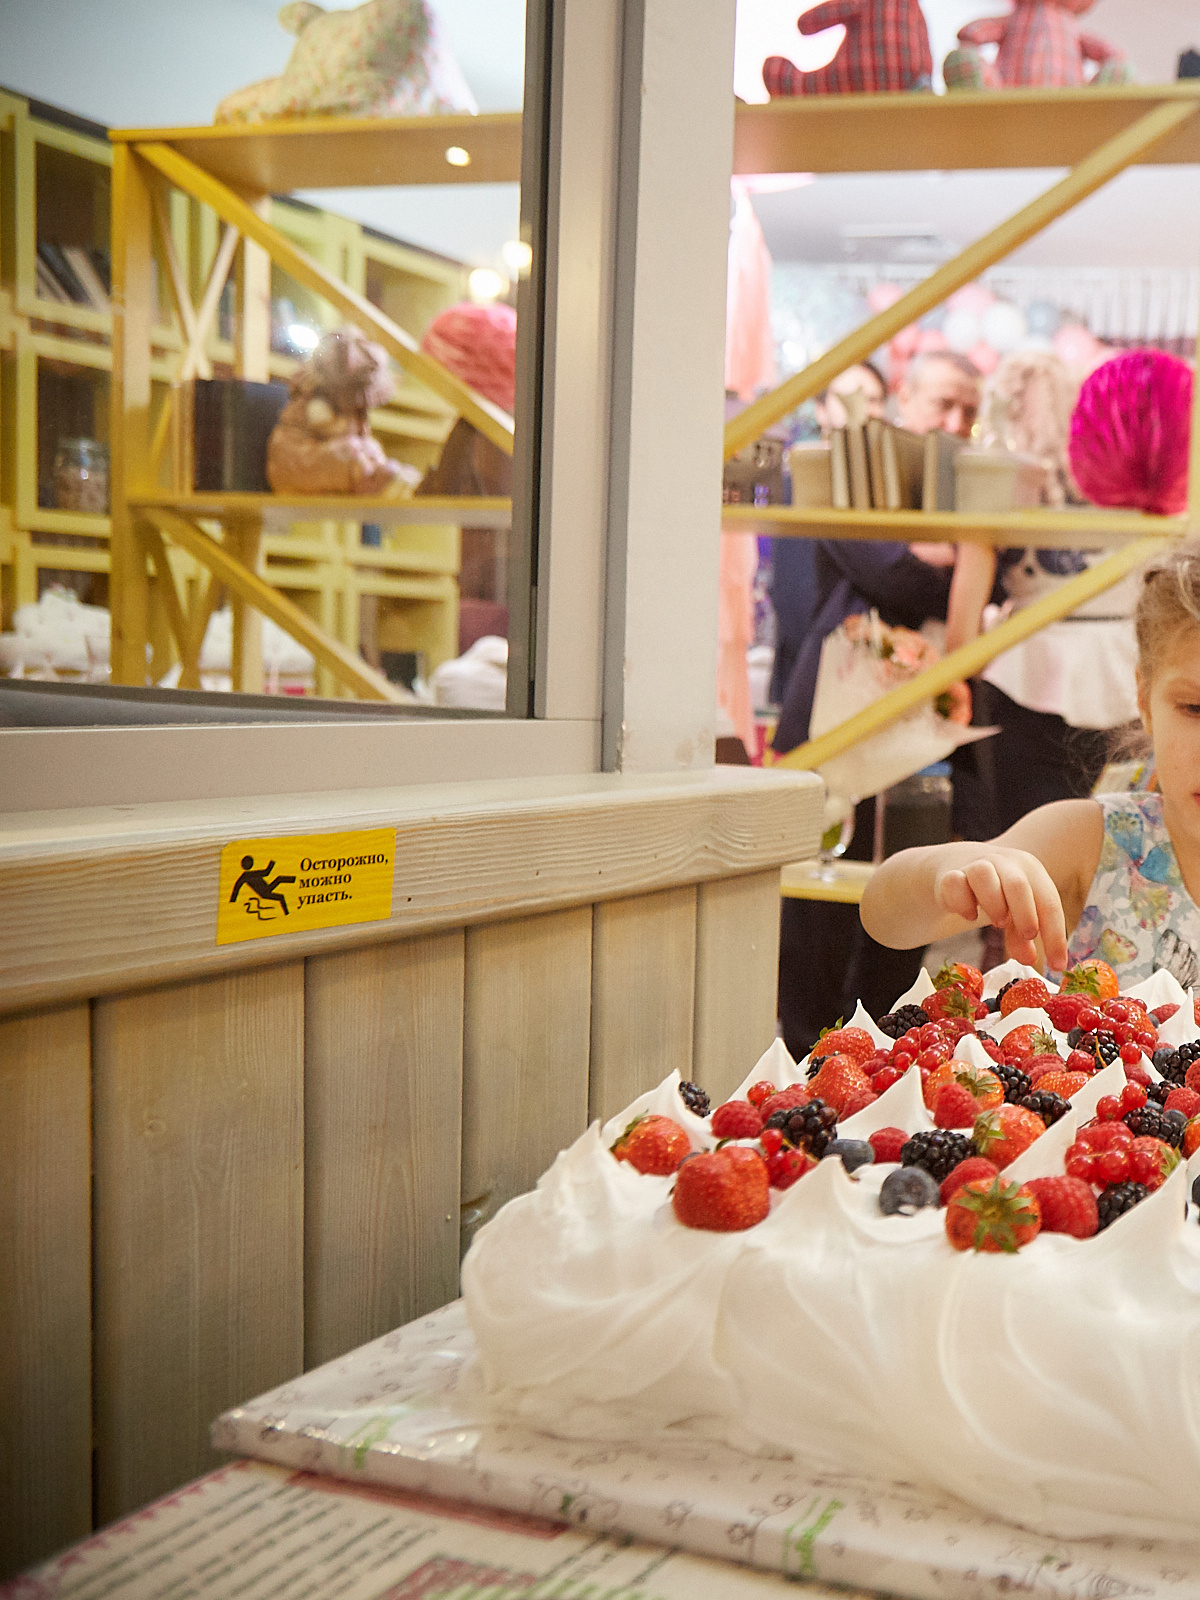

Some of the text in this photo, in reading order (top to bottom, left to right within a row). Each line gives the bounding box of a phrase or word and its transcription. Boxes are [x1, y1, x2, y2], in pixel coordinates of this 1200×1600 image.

[300, 854, 388, 871] Осторожно,
[299, 873, 352, 888] можно
[297, 891, 353, 909] упасть.
